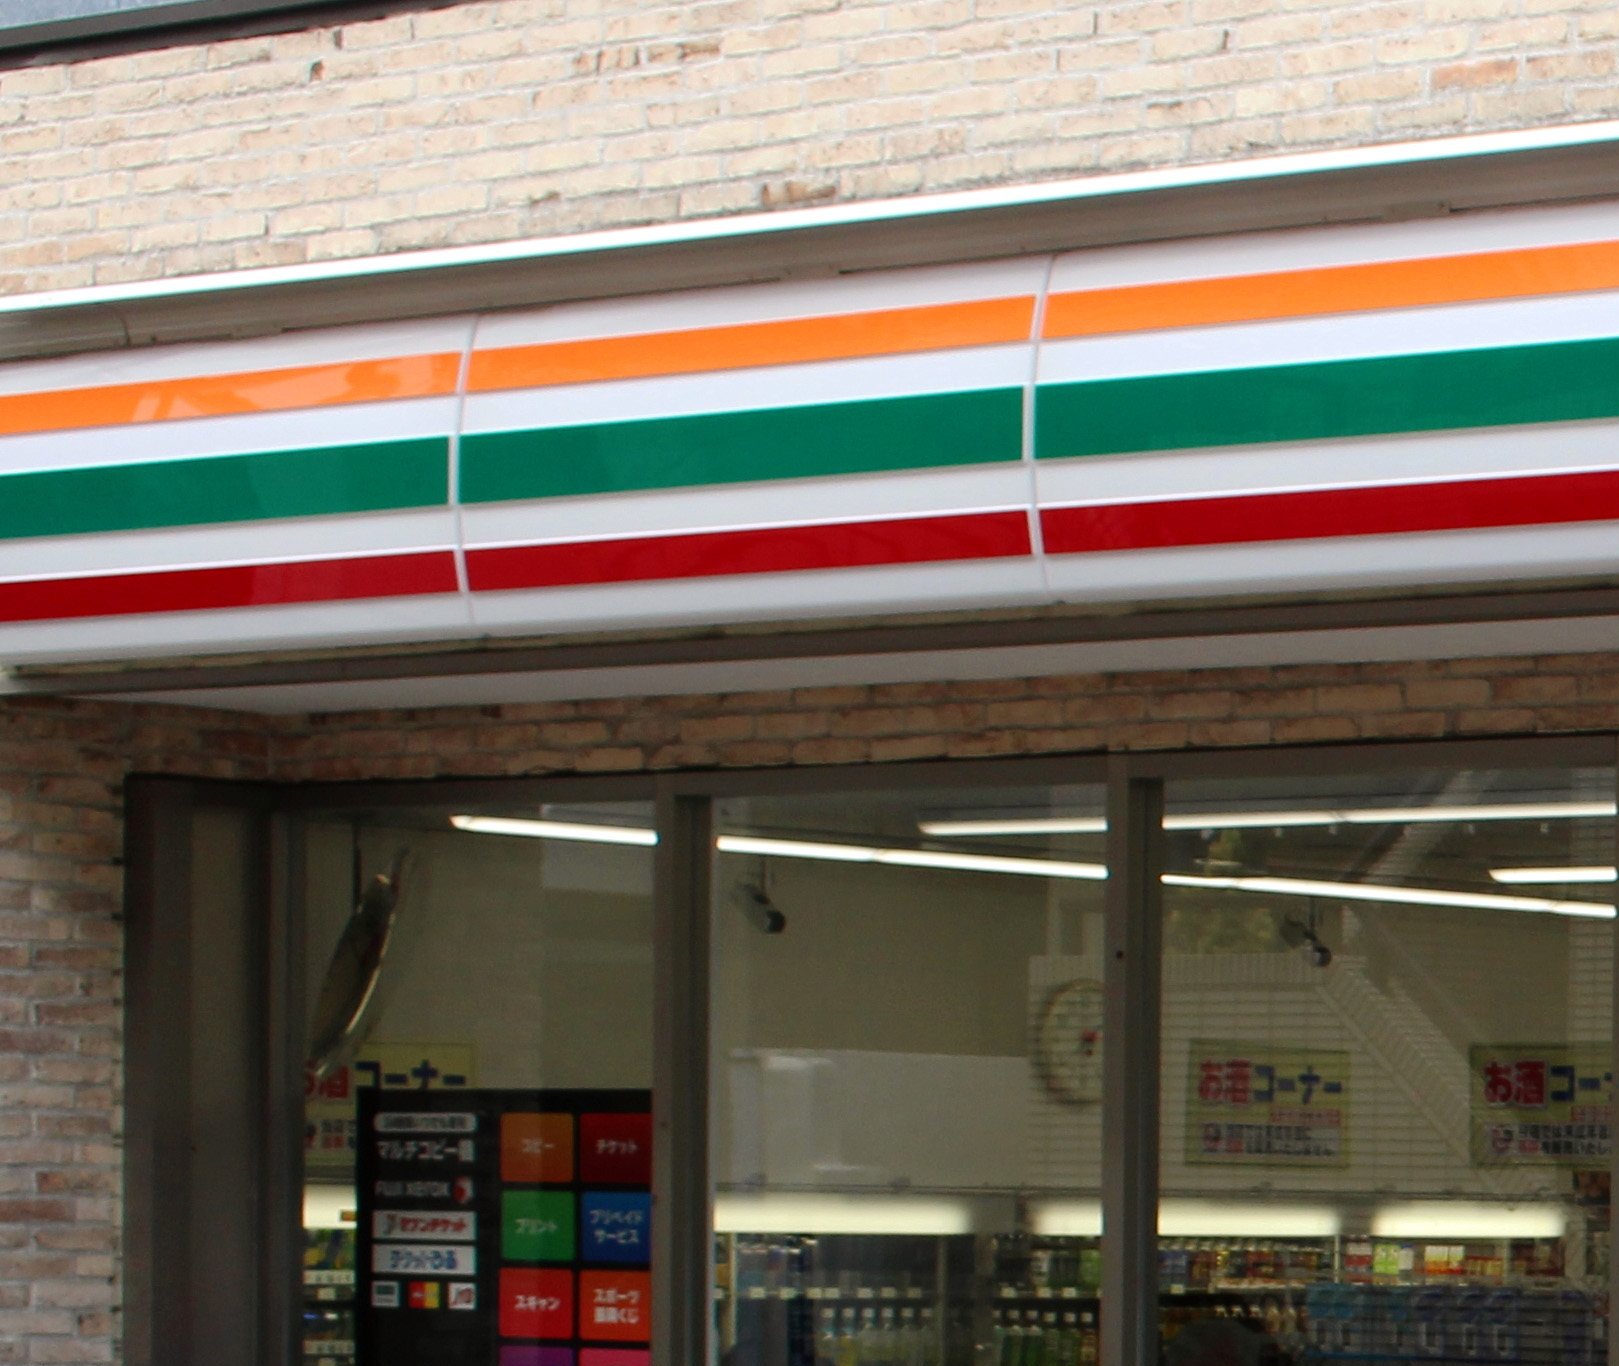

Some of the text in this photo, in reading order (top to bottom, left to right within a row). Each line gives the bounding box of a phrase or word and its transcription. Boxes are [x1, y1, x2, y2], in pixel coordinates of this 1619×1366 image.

[1199, 1058, 1343, 1109] お酒コーナー
[1484, 1059, 1612, 1106] お酒コー
[521, 1138, 556, 1154] コピー
[595, 1138, 639, 1154] チケット
[513, 1217, 558, 1235] プリント
[593, 1228, 640, 1245] サービス
[512, 1294, 560, 1312] スキャン
[592, 1287, 640, 1303] スポーツ
